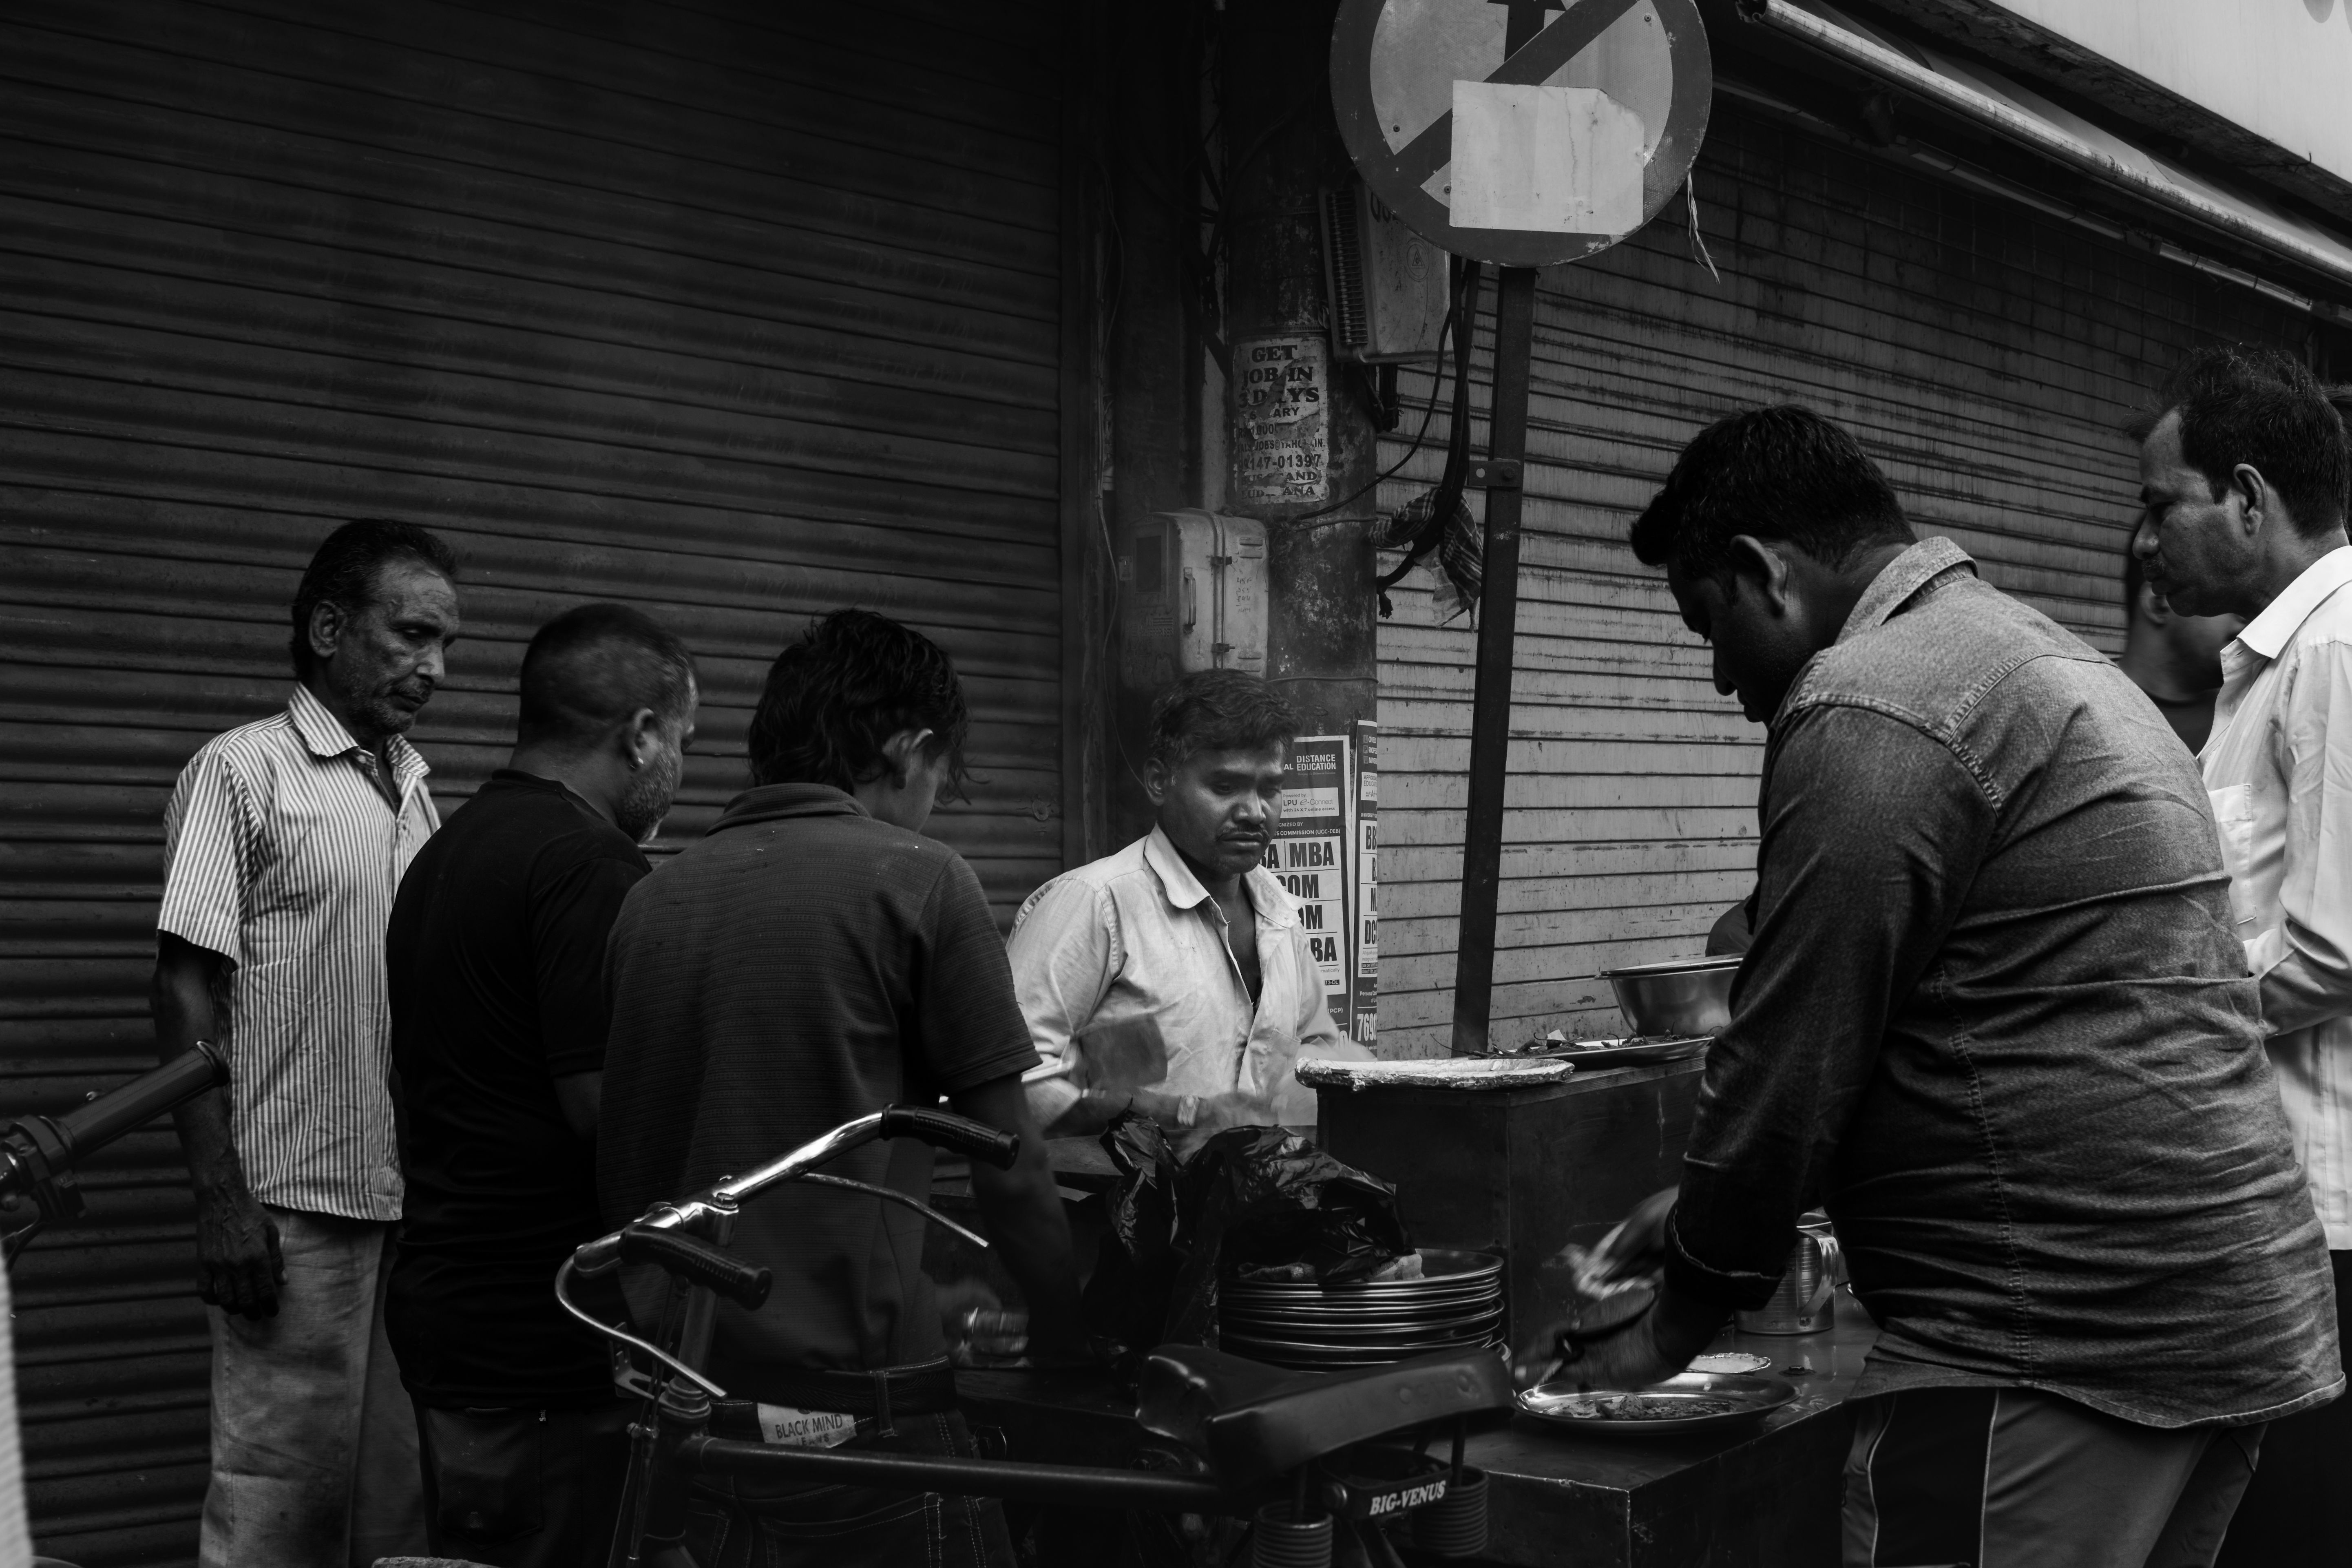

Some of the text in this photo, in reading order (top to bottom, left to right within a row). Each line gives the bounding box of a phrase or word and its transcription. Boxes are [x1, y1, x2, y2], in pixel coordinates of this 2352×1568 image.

[1252, 345, 1298, 363] GET
[1242, 367, 1313, 390] JOB IN
[1253, 387, 1319, 404] DYS
[1296, 754, 1336, 763] DISTANCE
[1297, 762, 1336, 771] EDUCATION
[1289, 841, 1334, 867] MBA
[775, 1414, 842, 1439] BLACK MIND
[1369, 1480, 1446, 1516] BIG-VENUS
